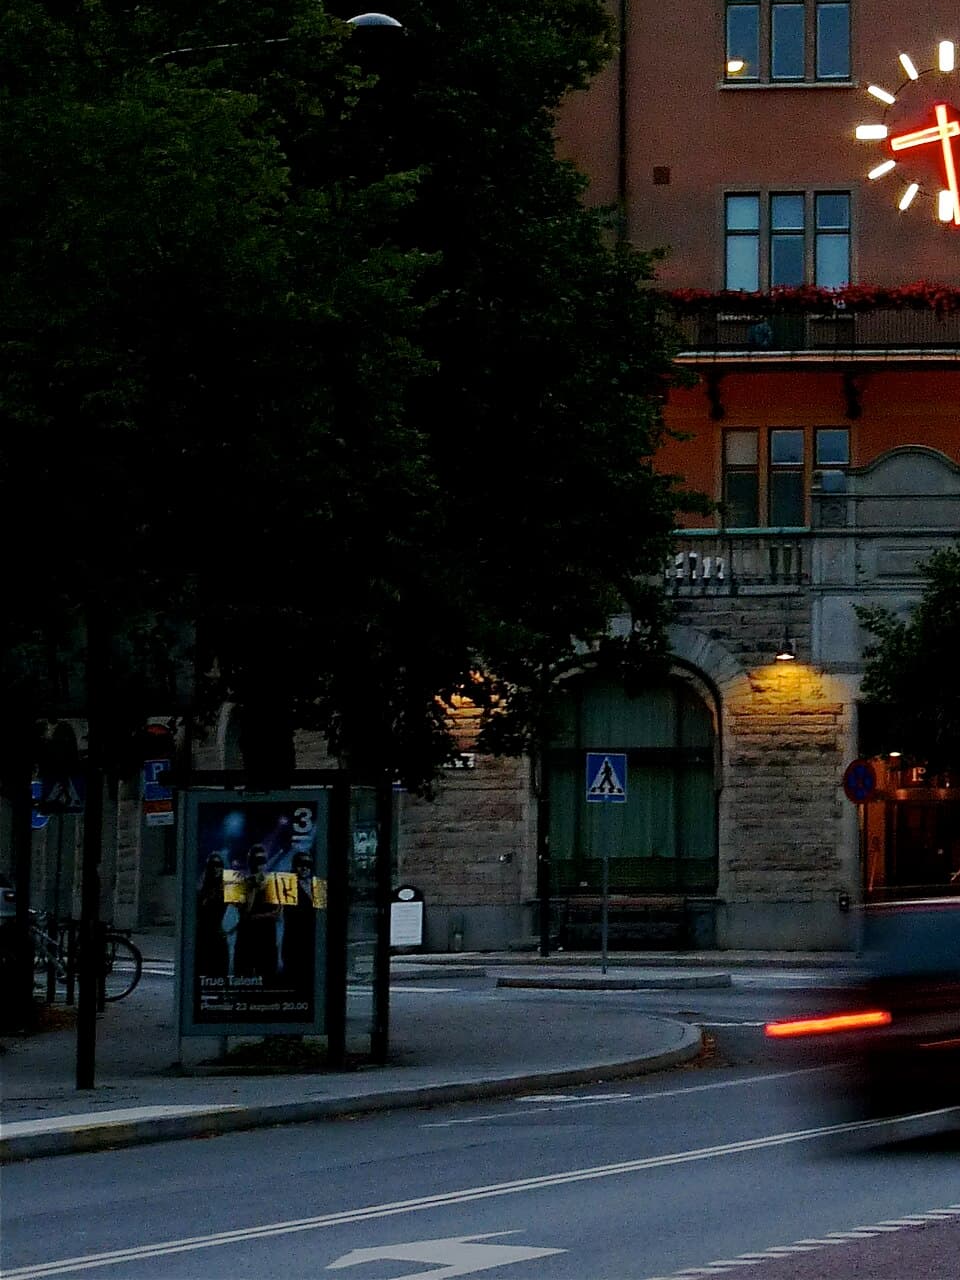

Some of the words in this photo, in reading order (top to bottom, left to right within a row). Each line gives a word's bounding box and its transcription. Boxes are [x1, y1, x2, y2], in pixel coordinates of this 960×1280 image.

[151, 763, 165, 780] P
[292, 806, 314, 834] 3
[199, 975, 225, 987] True
[227, 975, 264, 987] Talent
